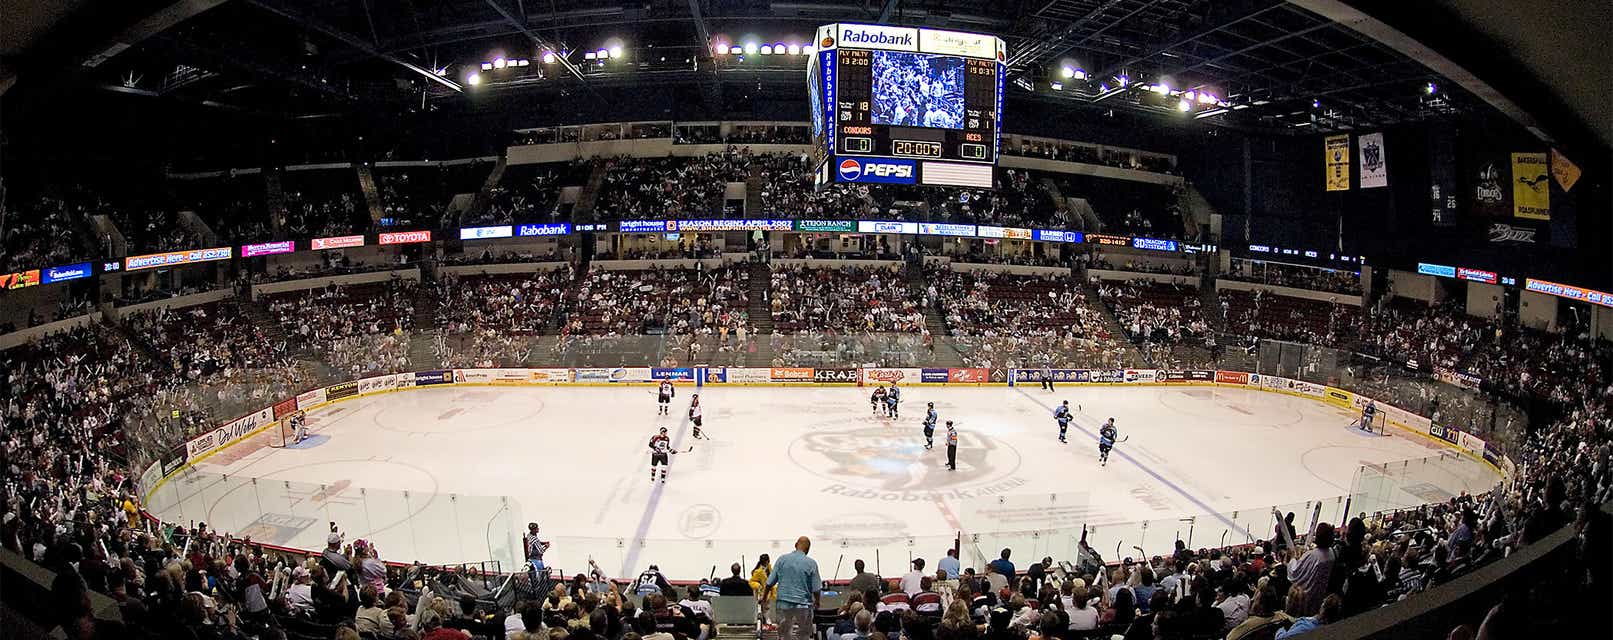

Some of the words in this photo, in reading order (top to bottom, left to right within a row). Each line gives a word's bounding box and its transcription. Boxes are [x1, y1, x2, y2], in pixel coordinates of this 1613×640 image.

[843, 29, 912, 47] Rabobank
[851, 58, 869, 66] 2:00
[825, 52, 833, 112] Rabobank
[859, 101, 869, 111] 18
[843, 126, 872, 135] CONDORS
[966, 133, 982, 142] ACES
[860, 139, 868, 151] 0
[896, 143, 930, 155] 20:00
[975, 146, 982, 157] 0
[863, 163, 913, 178] PEPSI
[520, 224, 566, 236] Rabobank
[394, 233, 428, 242] TOYOTA
[1134, 238, 1145, 249] 3D
[127, 254, 165, 269] Advertise
[165, 252, 183, 264] Here
[189, 250, 203, 262] Call
[1527, 280, 1563, 296] Advertise
[1563, 286, 1581, 299] Here
[1586, 291, 1601, 304] Call
[784, 370, 809, 379] Bobcat
[330, 382, 358, 392] KENYON
[215, 427, 233, 445] Del
[234, 416, 257, 438] Webb
[821, 483, 974, 502] Rabobank
[976, 477, 1025, 496] ARENA
